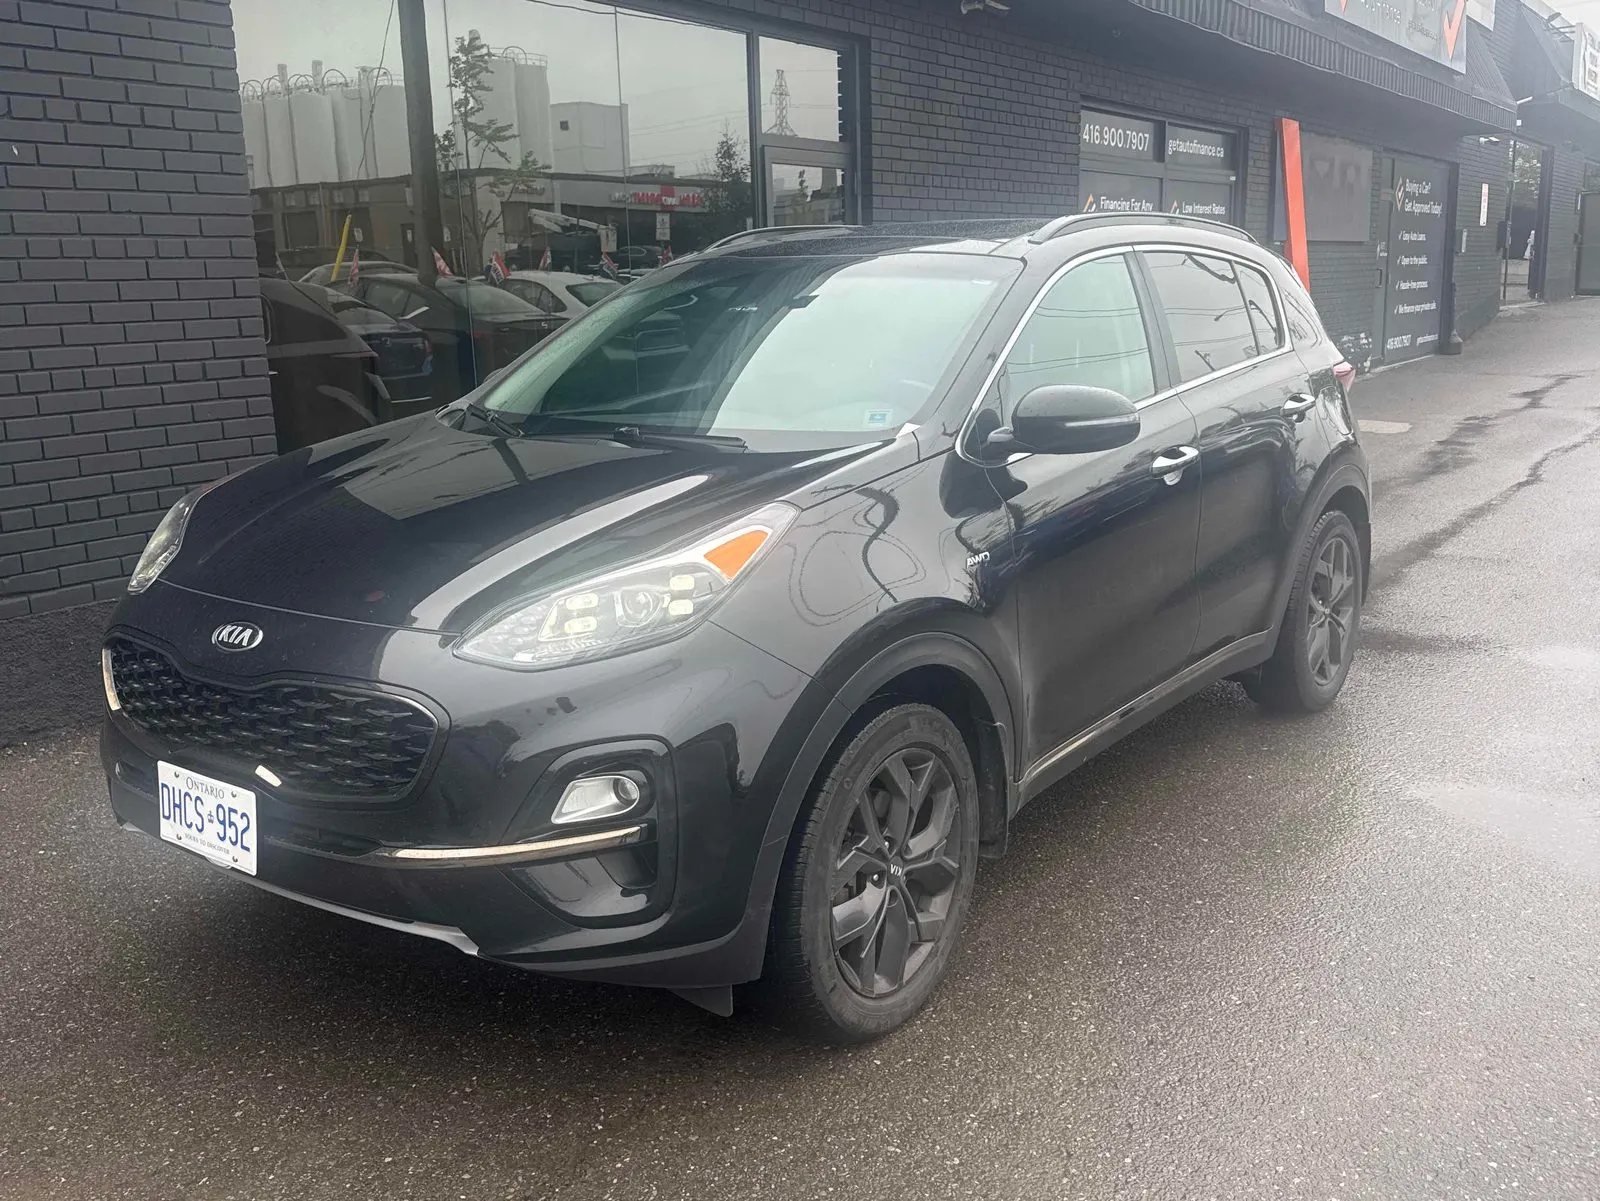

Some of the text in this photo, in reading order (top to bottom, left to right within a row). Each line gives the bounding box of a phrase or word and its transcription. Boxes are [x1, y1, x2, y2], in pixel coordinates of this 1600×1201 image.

[1083, 123, 1150, 152] 416.900.7907
[1168, 138, 1224, 158] getautofinance.ca
[1100, 196, 1153, 212] Financing For Any
[1182, 202, 1226, 215] Low Interest Rates
[966, 551, 990, 569] AWD
[218, 624, 253, 647] KIA
[185, 776, 225, 800] ONTARIO
[160, 782, 251, 853] DHCS 952
[890, 863, 903, 877] KIA
